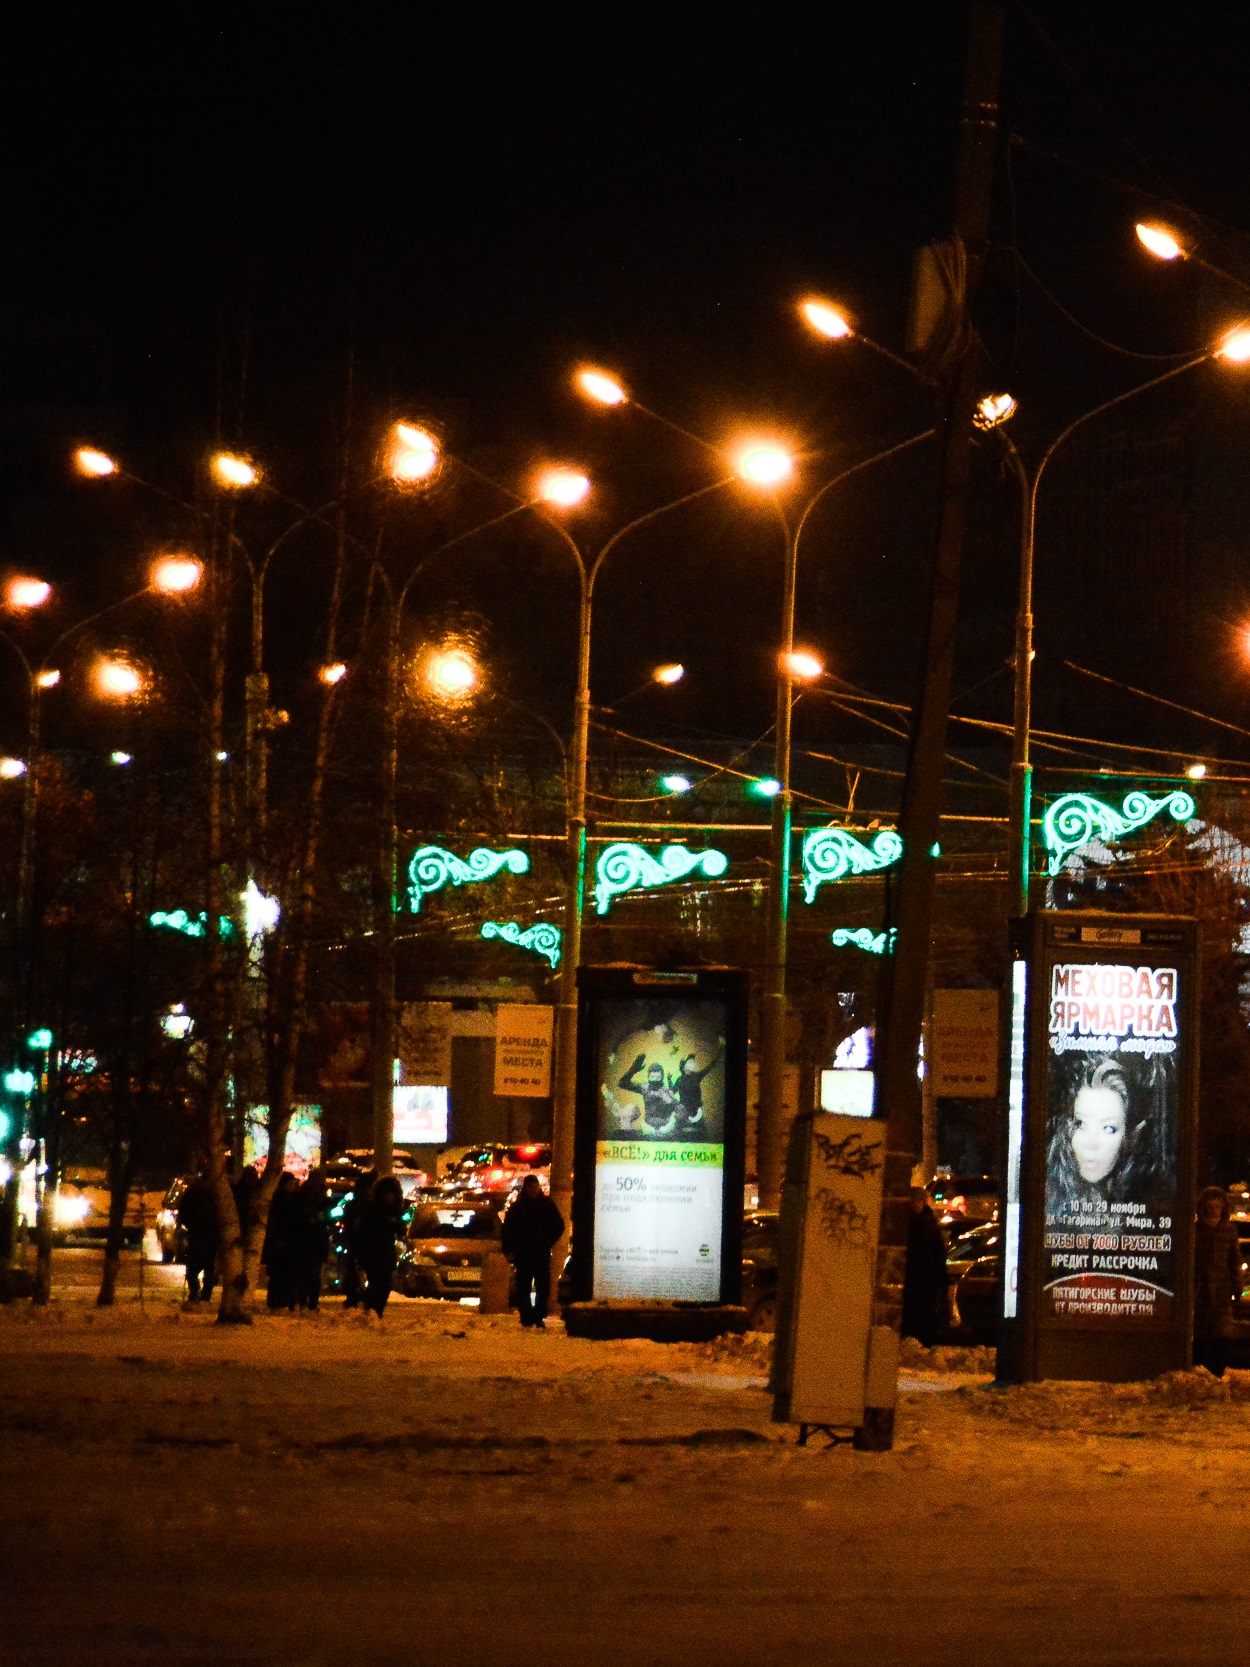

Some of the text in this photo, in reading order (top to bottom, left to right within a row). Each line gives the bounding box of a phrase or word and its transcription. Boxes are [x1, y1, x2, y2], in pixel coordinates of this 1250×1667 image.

[1053, 967, 1174, 1000] МЕХОВАЯ
[1051, 1000, 1174, 1033] ЯРМАРКА
[500, 1036, 548, 1048] АРЕНДА
[502, 1056, 543, 1067] МЕСТА
[653, 1150, 678, 1162] для
[680, 1150, 717, 1162] семьи
[616, 1177, 647, 1192] 50%
[1070, 1200, 1080, 1212] 10
[1082, 1201, 1093, 1212] по
[1096, 1200, 1108, 1213] 29
[1110, 1201, 1146, 1215] ноября
[1125, 1216, 1156, 1229] Мира,
[1159, 1216, 1172, 1229] 39
[1076, 1233, 1091, 1249] ОТ
[1092, 1233, 1119, 1251] 7000
[1121, 1234, 1172, 1252] РУБЛЕЙ
[1051, 1254, 1158, 1270] КРЕДИТ РАССРОЧКА
[1120, 1288, 1156, 1301] ШУБЫ
